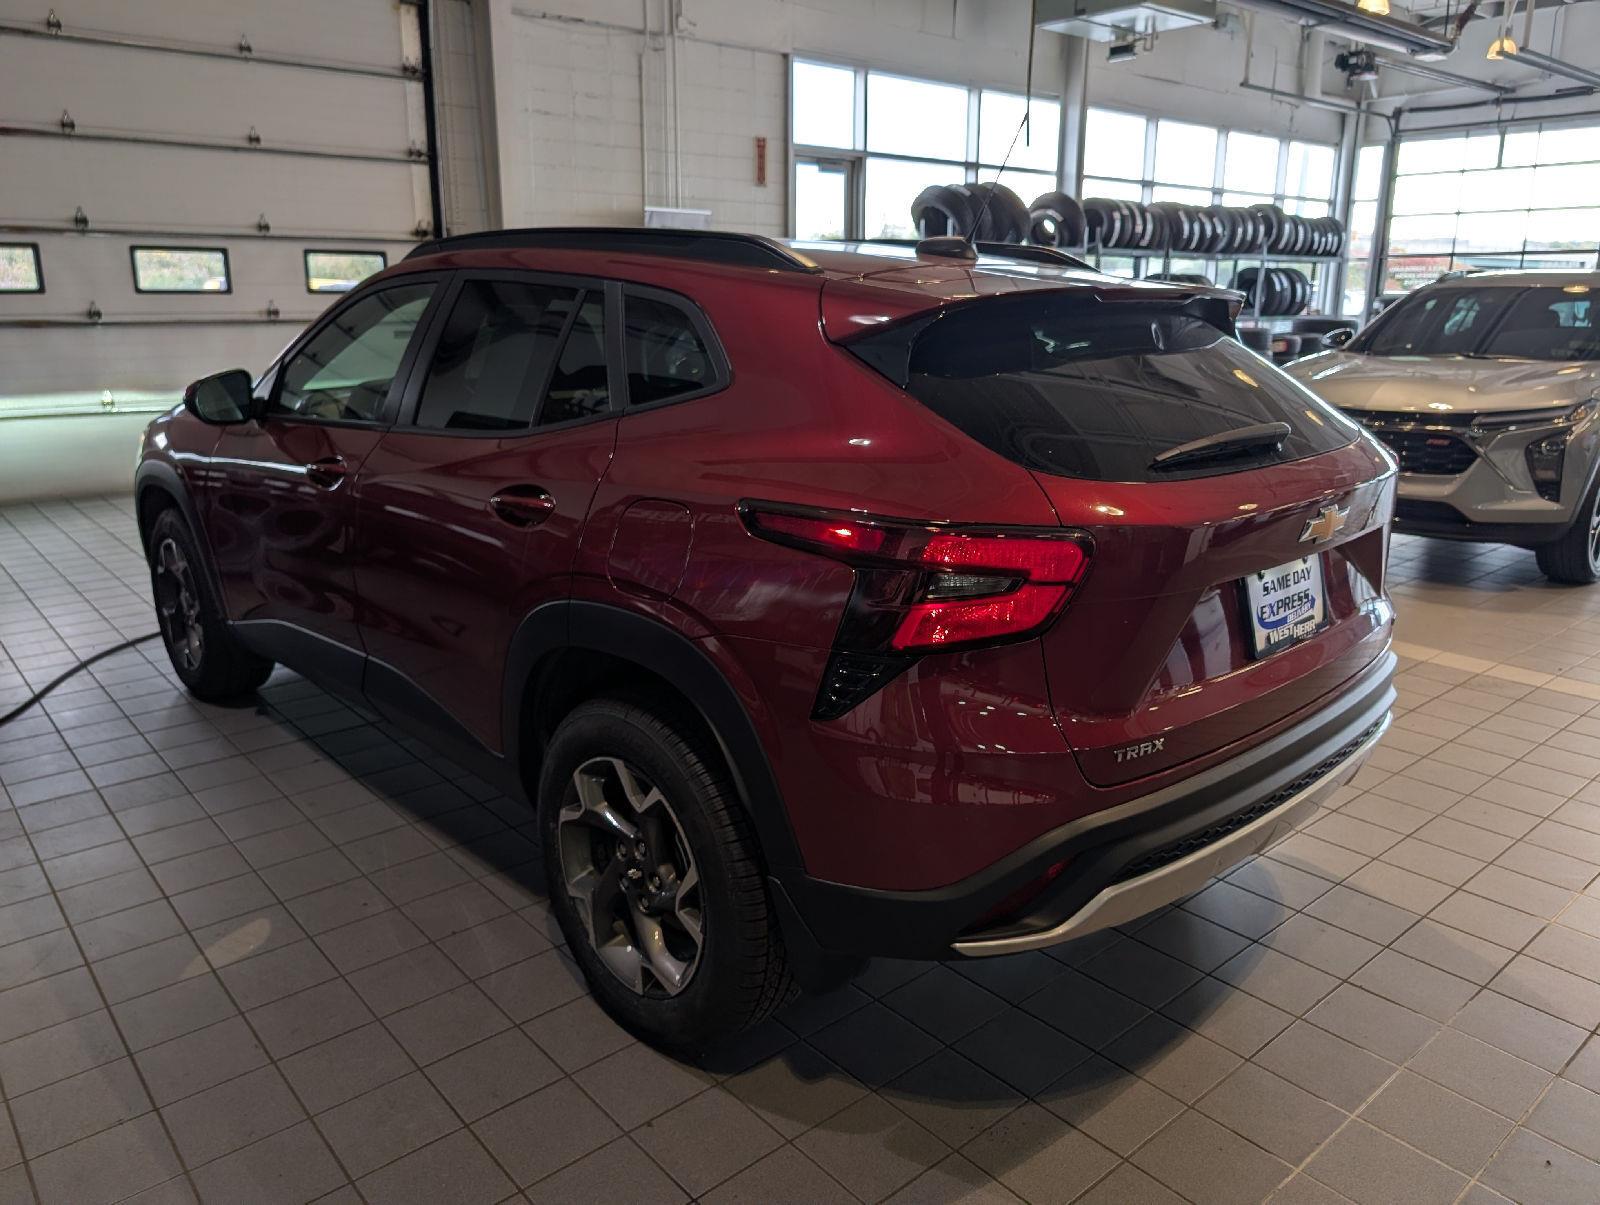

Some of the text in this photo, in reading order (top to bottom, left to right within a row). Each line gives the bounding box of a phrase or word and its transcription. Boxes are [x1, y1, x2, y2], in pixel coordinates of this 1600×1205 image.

[1263, 565, 1312, 597] SAME DAY
[1260, 588, 1310, 621] EXPRESS
[1269, 623, 1295, 645] WEST
[1293, 619, 1316, 638] HERR
[1113, 737, 1165, 762] TRAX
